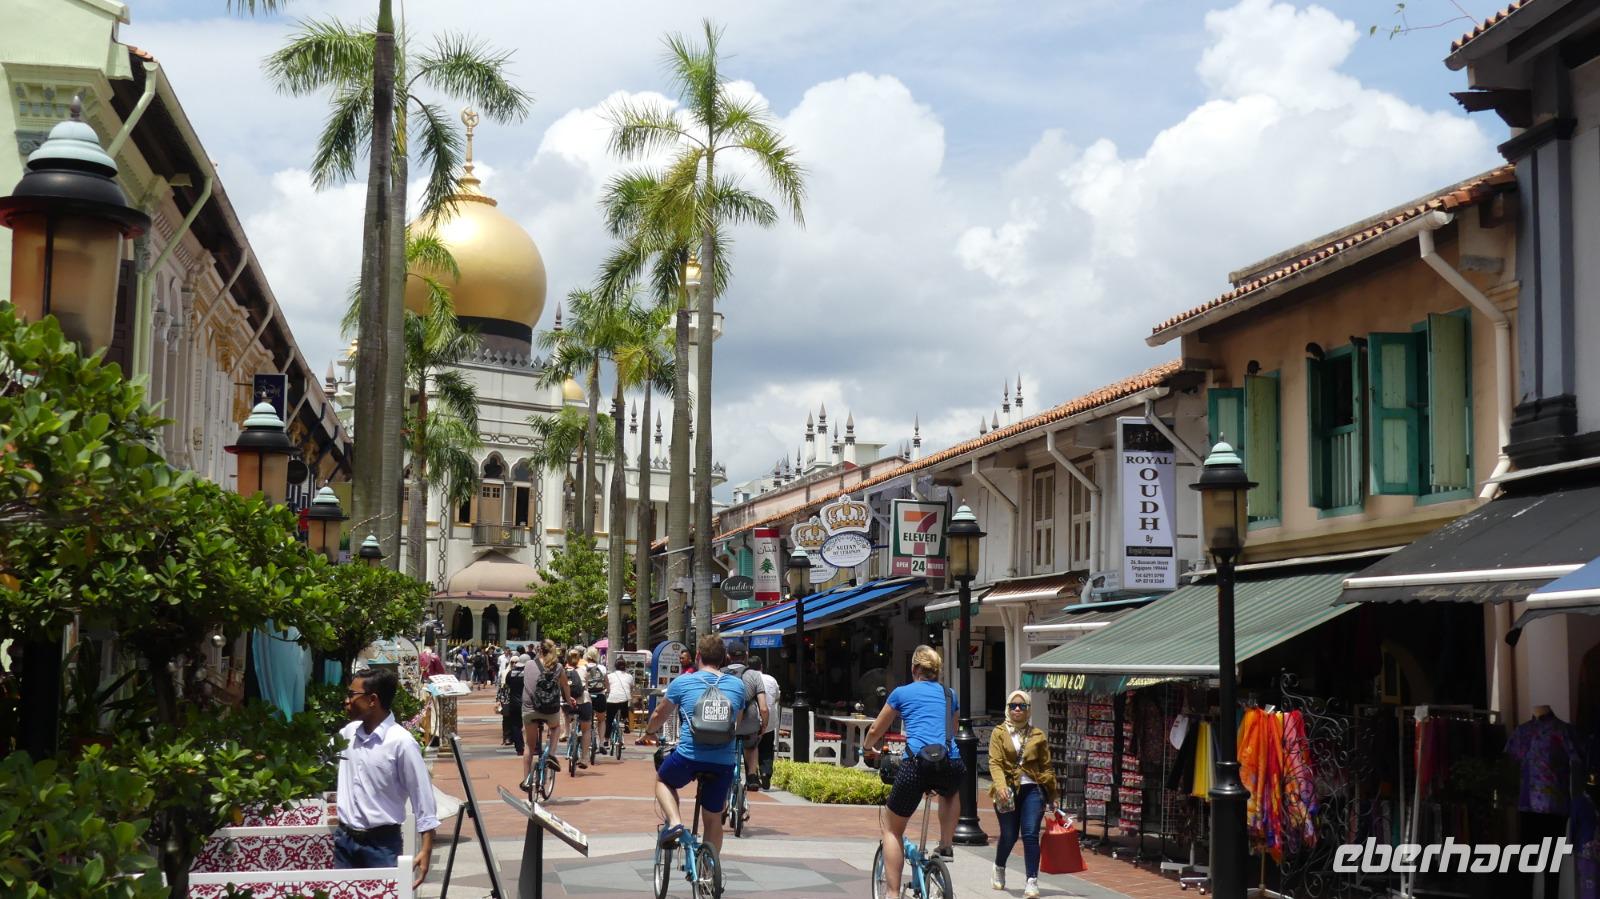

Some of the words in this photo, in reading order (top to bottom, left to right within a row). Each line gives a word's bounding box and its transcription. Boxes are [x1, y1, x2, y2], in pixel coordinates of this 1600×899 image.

[1126, 456, 1172, 465] ROYAL
[1139, 467, 1160, 531] OUDH
[904, 511, 938, 555] 7
[1145, 534, 1153, 544] By
[912, 560, 926, 572] 24
[1068, 674, 1074, 689] &
[1075, 674, 1086, 690] CO
